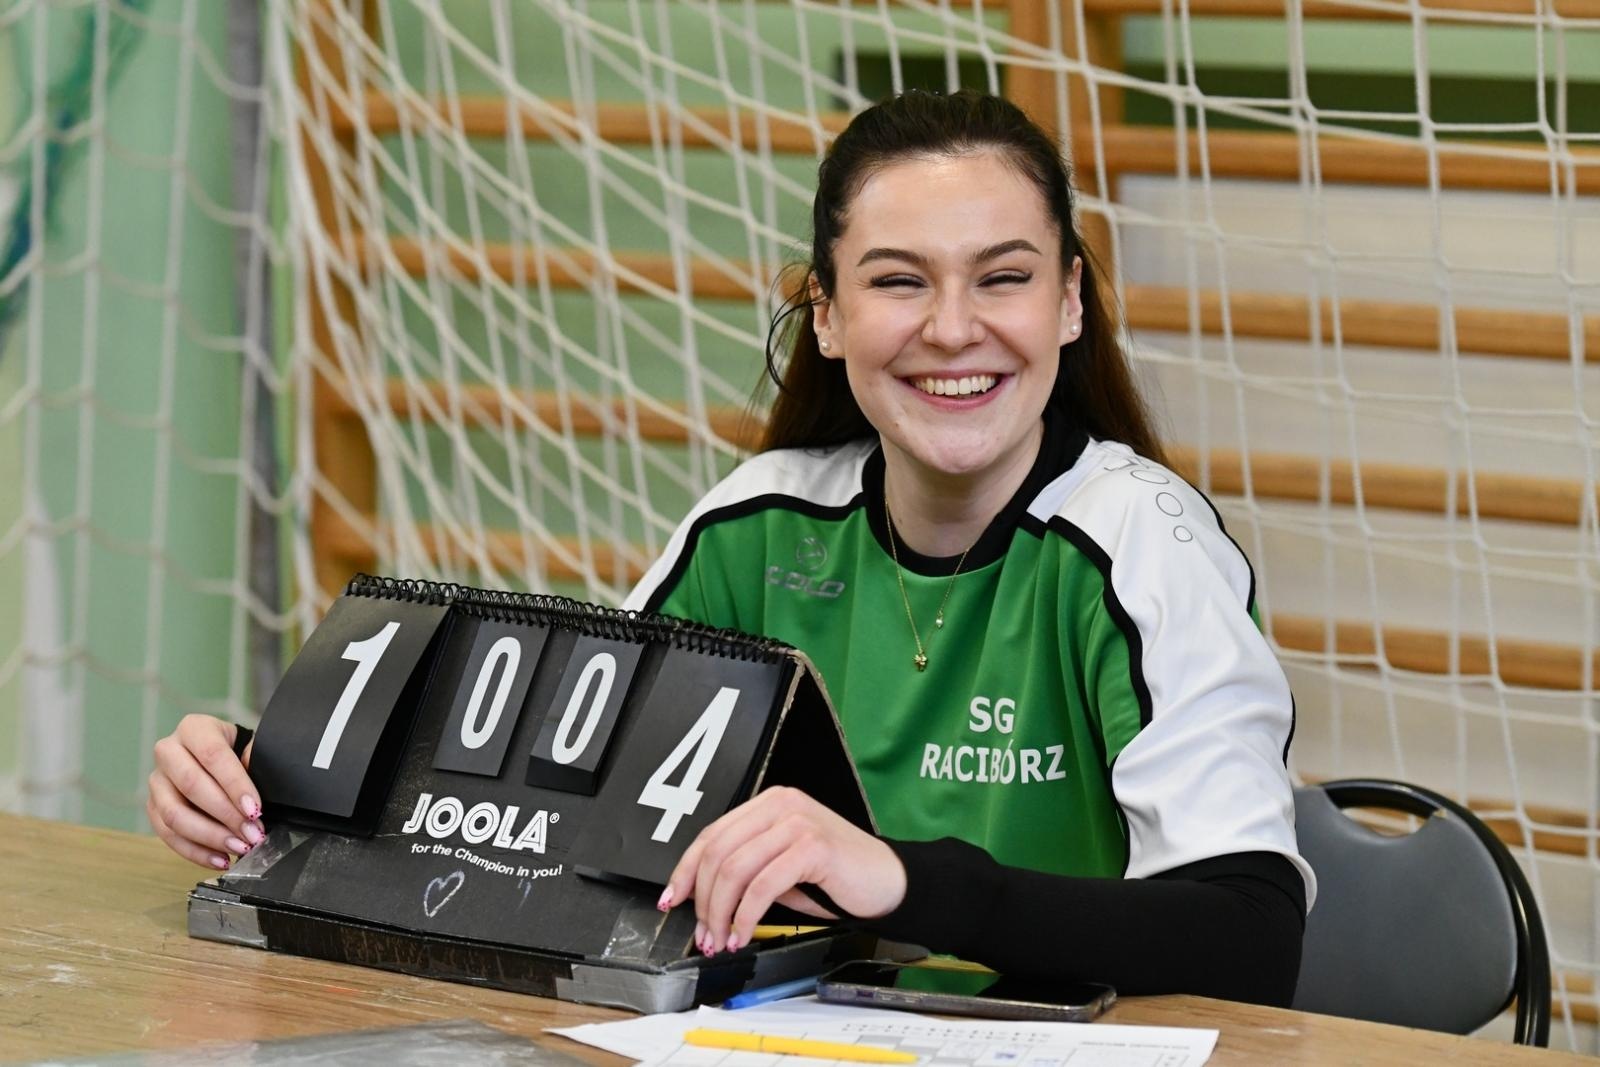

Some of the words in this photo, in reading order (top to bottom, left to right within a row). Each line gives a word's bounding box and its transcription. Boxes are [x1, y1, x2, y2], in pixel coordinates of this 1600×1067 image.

[311, 621, 401, 770] 1
[460, 636, 522, 750] 0
[551, 652, 617, 766] 0
[636, 686, 741, 843] 4
[968, 696, 1016, 734] SG
[919, 739, 1067, 785] RACIBÓRZ
[411, 843, 431, 854] for
[432, 843, 452, 856] the
[454, 847, 514, 876] Champion
[516, 865, 530, 877] in
[532, 863, 563, 880] you!
